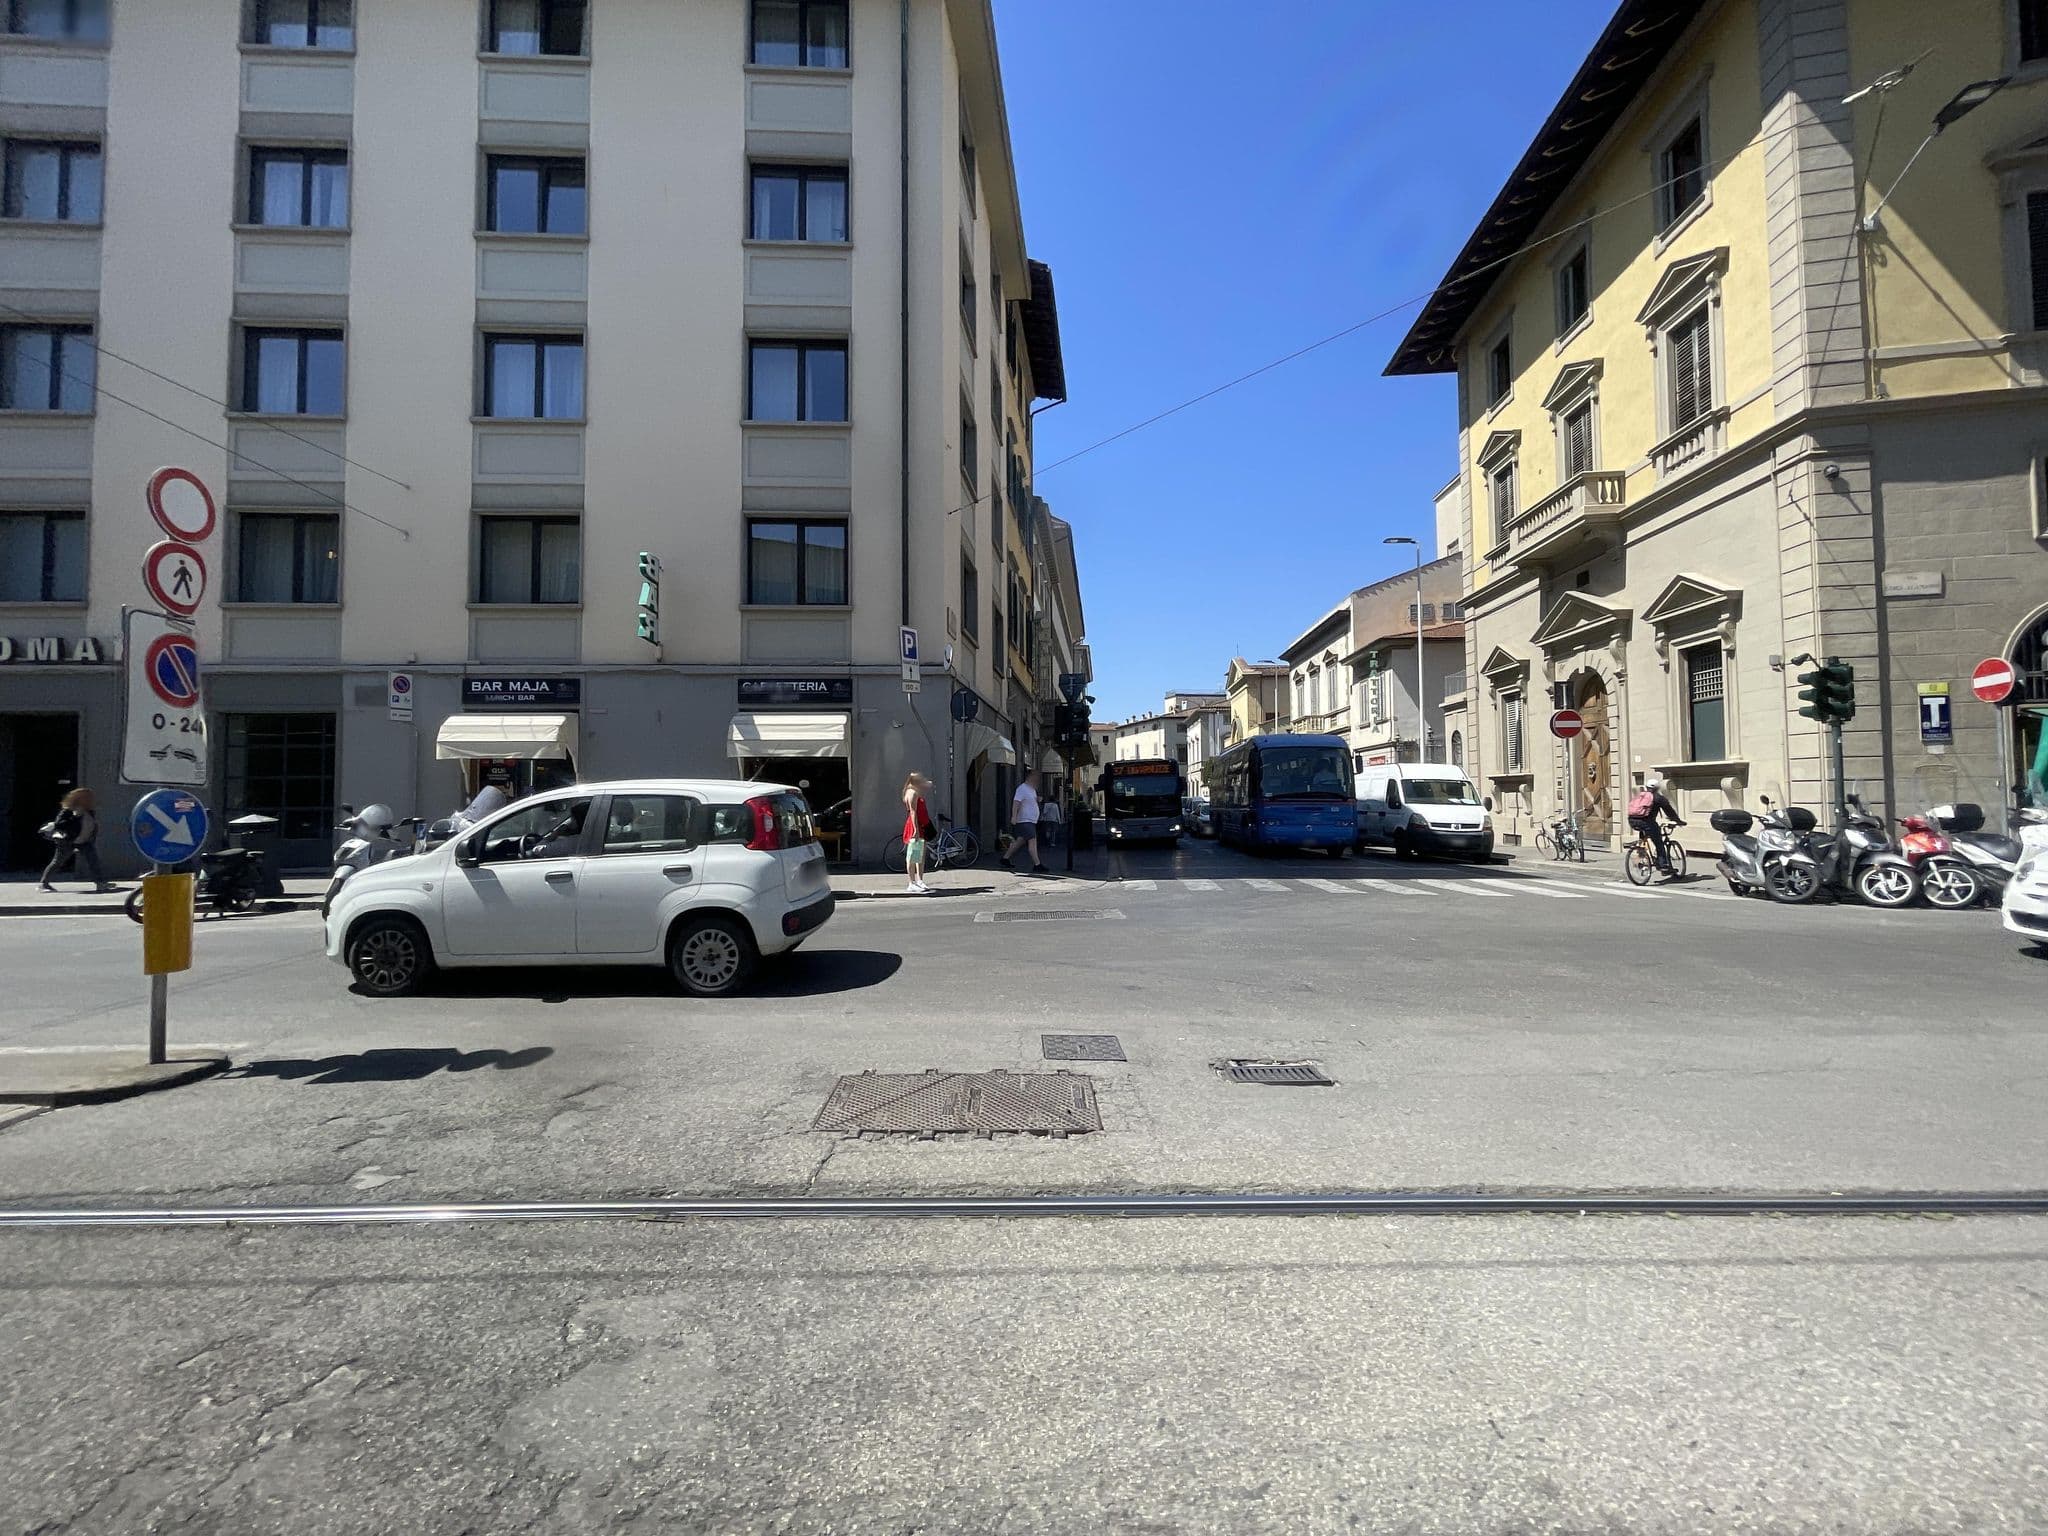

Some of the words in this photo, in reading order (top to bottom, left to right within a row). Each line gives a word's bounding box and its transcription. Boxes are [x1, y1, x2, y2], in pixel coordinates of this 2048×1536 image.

[637, 551, 659, 646] BAR
[904, 633, 914, 655] P
[471, 681, 502, 692] BAR
[508, 681, 550, 692] MAJA
[742, 681, 827, 692] CAFTERIA
[1369, 650, 1380, 734] TRATTORIA
[1922, 697, 1946, 728] T
